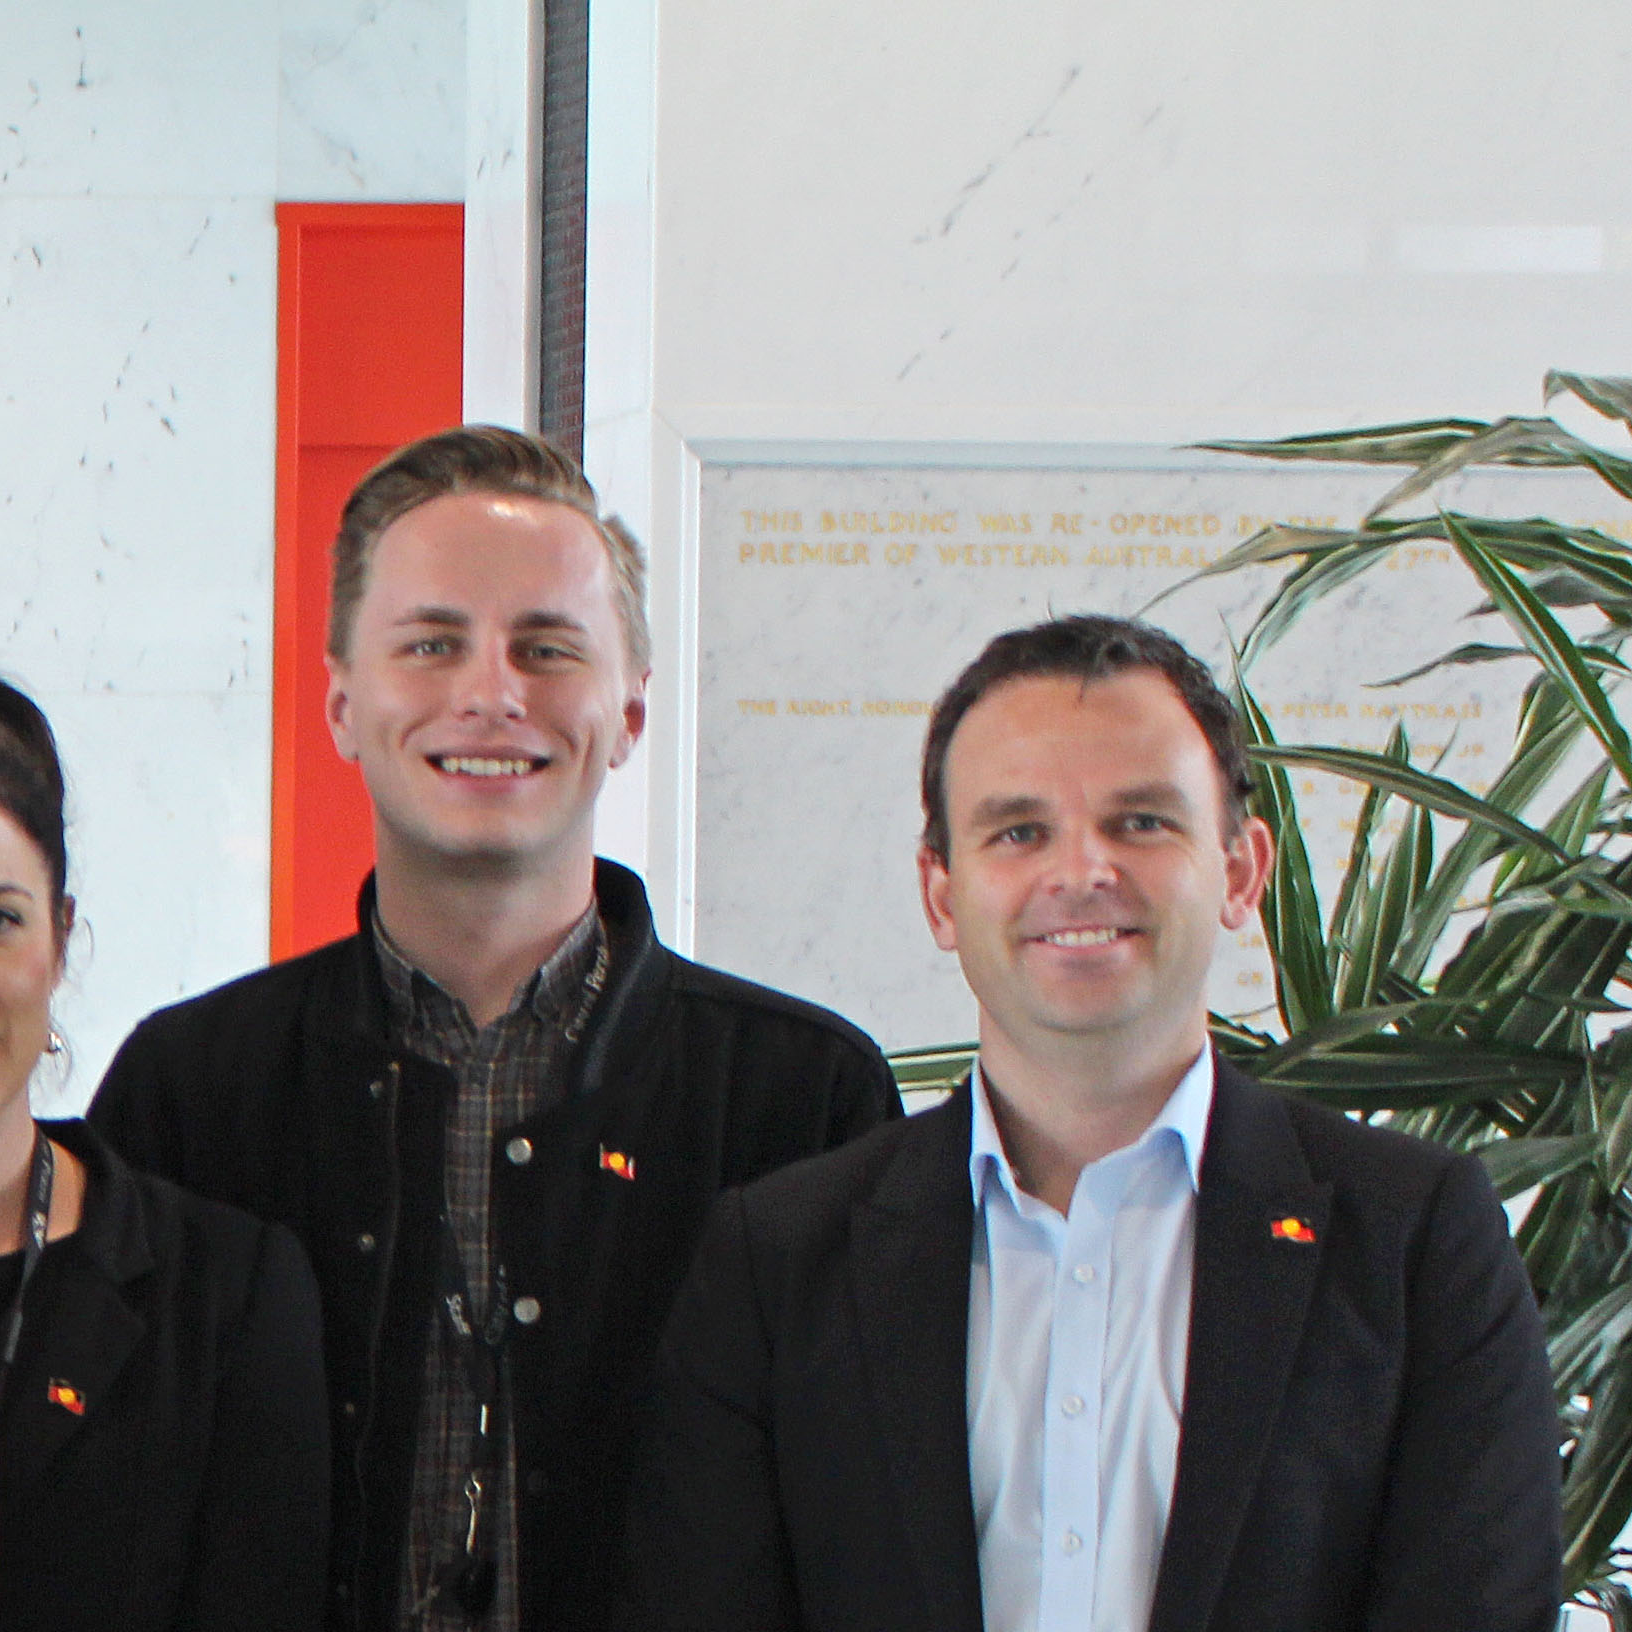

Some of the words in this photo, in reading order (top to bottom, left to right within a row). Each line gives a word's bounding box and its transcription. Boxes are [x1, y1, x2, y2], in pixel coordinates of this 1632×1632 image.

[739, 509, 804, 533] THIS
[819, 510, 958, 535] BUILDING
[976, 512, 1033, 535] WAS
[737, 541, 871, 567] PREMIER
[883, 542, 918, 566] OF
[935, 543, 1070, 568] WESTERN
